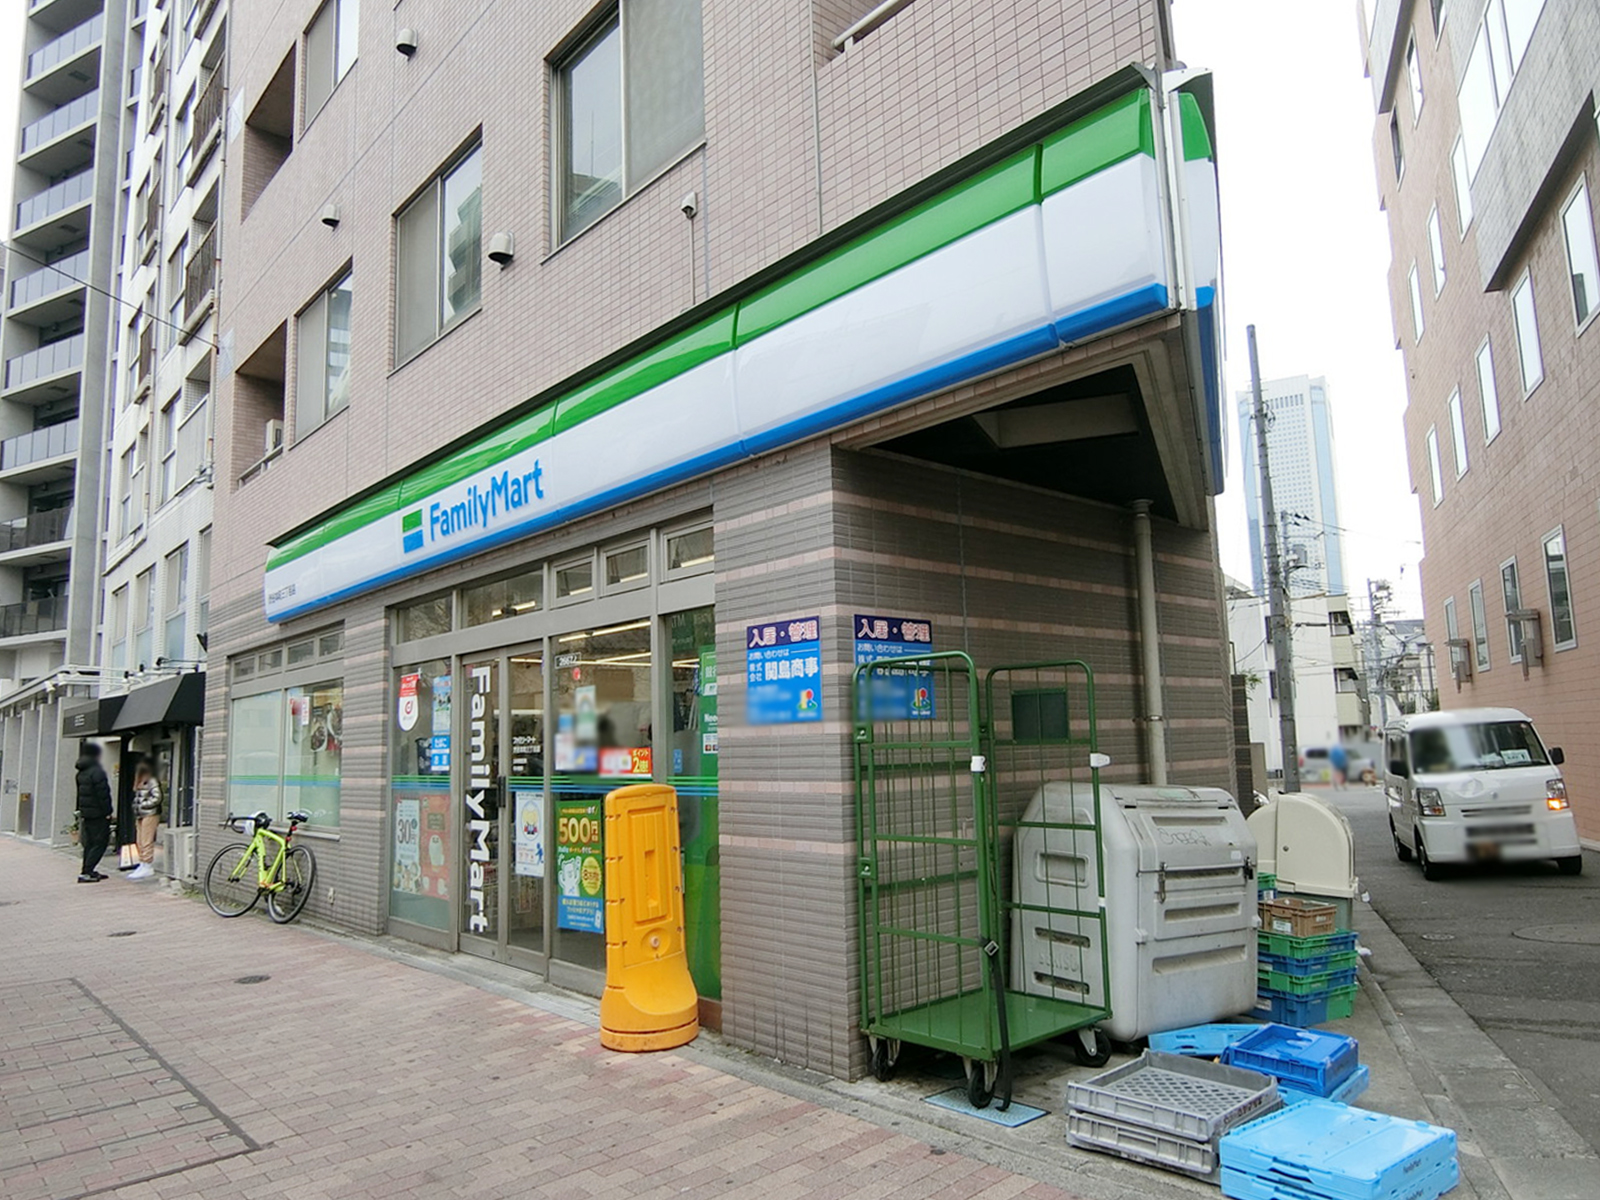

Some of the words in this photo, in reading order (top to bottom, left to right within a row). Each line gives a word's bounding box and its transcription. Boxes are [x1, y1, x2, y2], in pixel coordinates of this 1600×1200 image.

[430, 459, 544, 542] FamilyMart
[749, 620, 818, 648] 入居・管理
[857, 618, 931, 642] 入居・管理
[465, 666, 492, 933] FamilyMart
